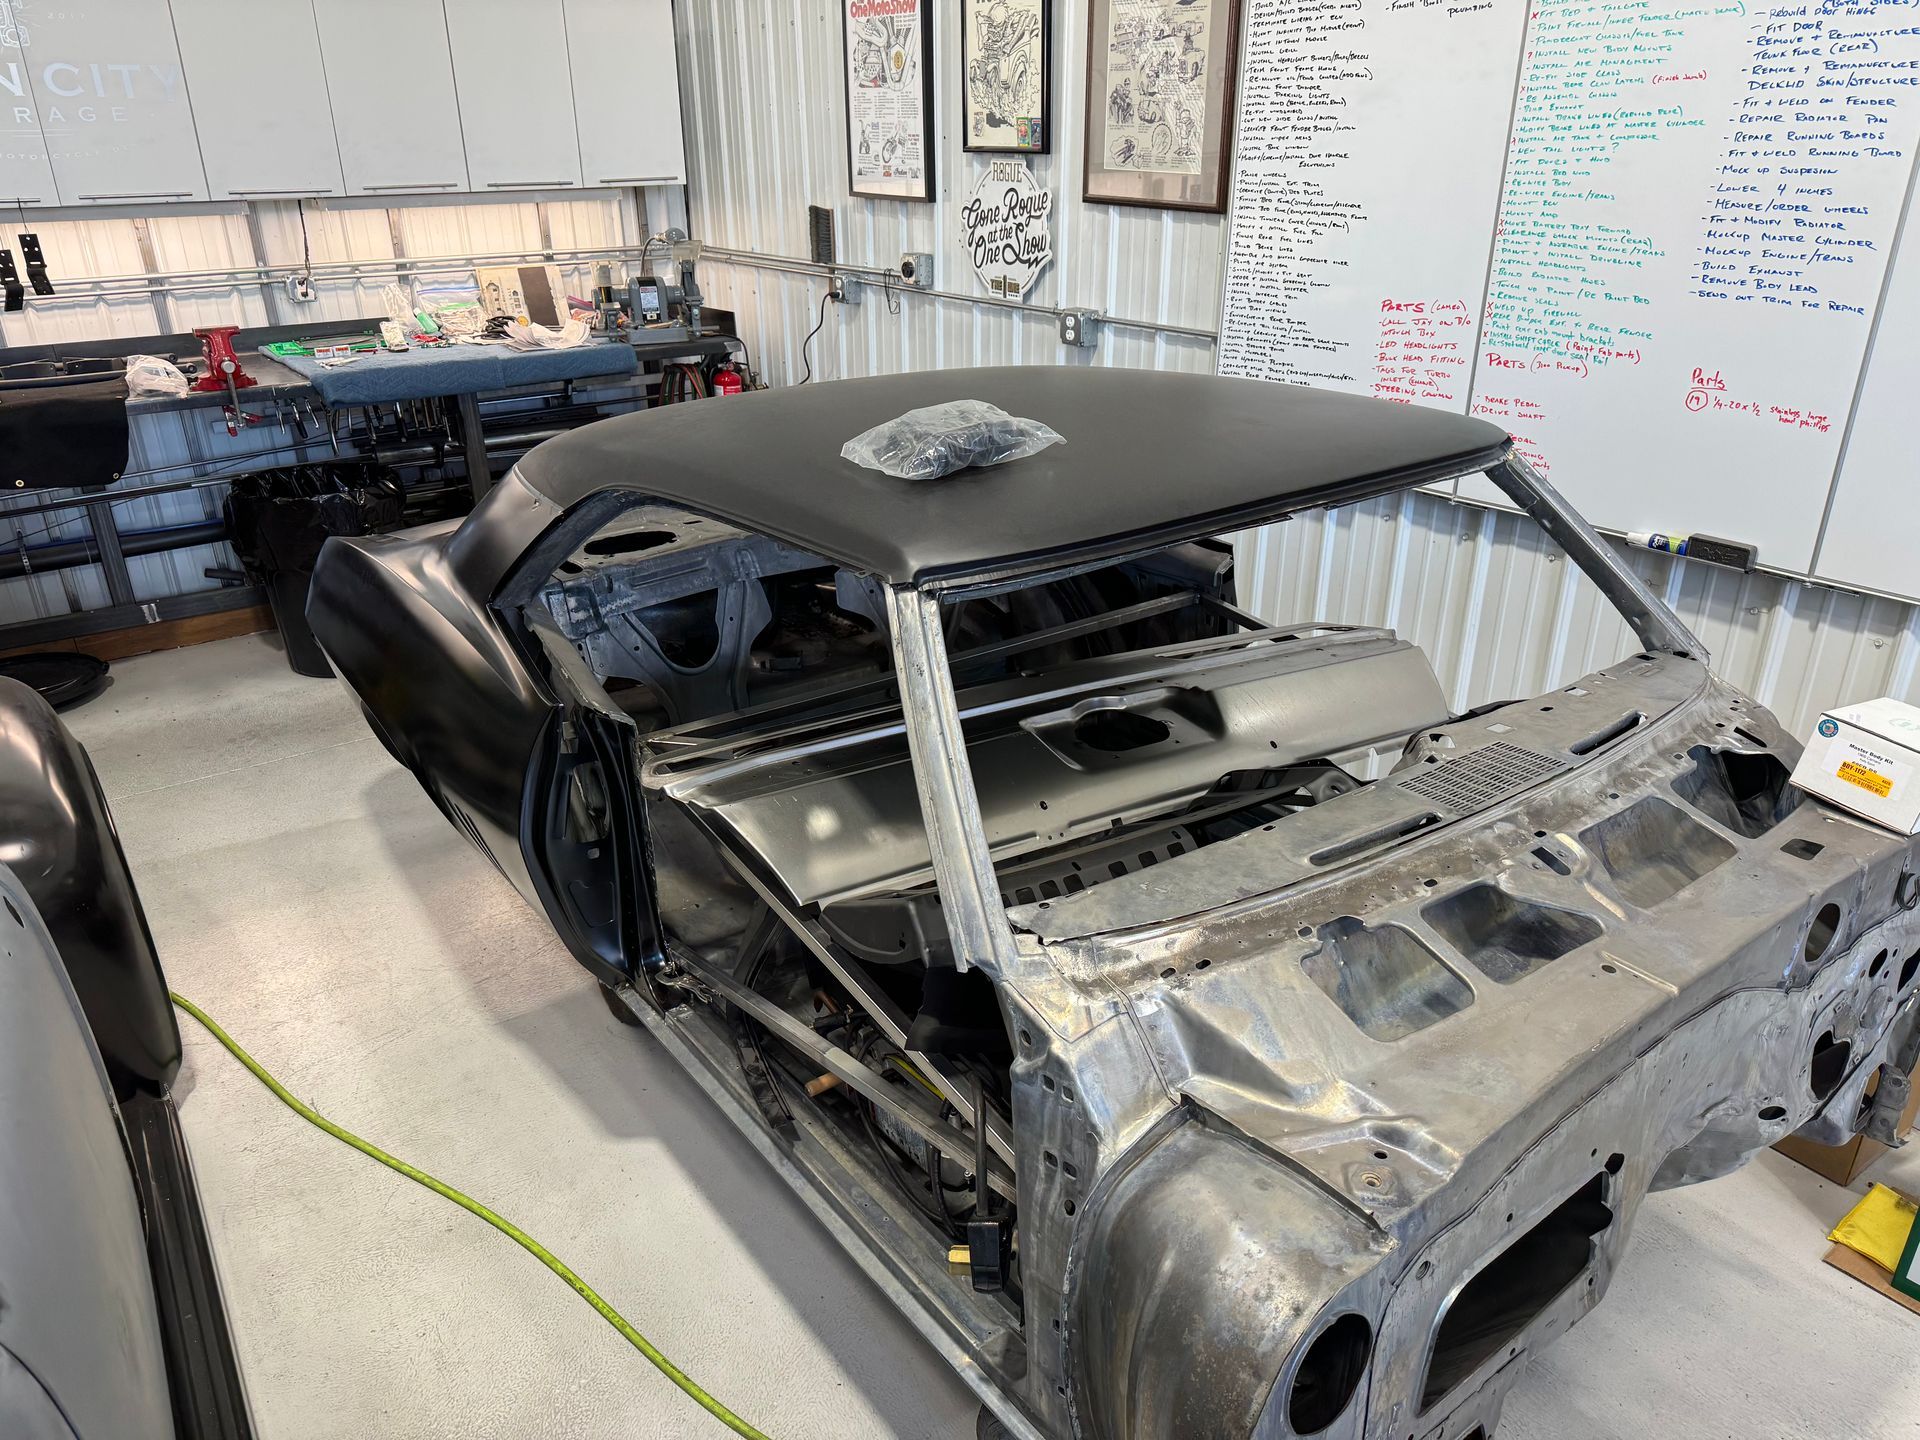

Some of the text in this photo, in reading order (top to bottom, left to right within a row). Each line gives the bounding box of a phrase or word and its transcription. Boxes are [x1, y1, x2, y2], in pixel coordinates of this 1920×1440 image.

[1560, 8, 1581, 17] BED
[1601, 2, 1649, 11] TAILGATE
[1769, 6, 1806, 19] Rebuild
[1766, 21, 1823, 34] FIT DOOR
[1756, 36, 1804, 47] REMOVE
[1534, 50, 1571, 58] INSTALL
[1753, 38, 1879, 61] TRUNK FLOOR (REAR)
[1532, 62, 1568, 70] INSTALL
[1752, 65, 1797, 76] REMOVE
[42, 62, 179, 102] CITY
[1743, 96, 1760, 109] FIT
[1778, 98, 1809, 106] WELD
[1845, 96, 1898, 107] FENDER
[1739, 114, 1785, 123] REPAIR
[1794, 112, 1848, 122] RADIATOR
[1734, 130, 1885, 143] REPAIR RUNNING BOARDS
[1728, 149, 1746, 158] FIT
[1763, 149, 1797, 157] WELD
[1808, 147, 1859, 157] RUNNING
[992, 161, 1023, 183] ROGUE
[1716, 183, 1833, 197] LOWER 4 INCHES
[1714, 198, 1869, 215] MEASURE/ORDER WHEELS
[962, 187, 1049, 248] Gone Rogue
[1709, 215, 1846, 231] FIT MODIFY RADIATOR
[988, 224, 1014, 244] at the
[973, 222, 1049, 270] One Show
[1761, 232, 1805, 243] MASTER
[1815, 235, 1877, 251] CYLINDER
[1761, 248, 1854, 265] ENGINE/TRANS
[1702, 261, 1804, 277] BUILD EXHAUST
[1701, 274, 1818, 294] REMOVE BODY LEAD
[1381, 298, 1425, 313] PARTS
[1698, 290, 1728, 300] SEND
[1762, 296, 1793, 306] TRIM
[1801, 300, 1820, 309] FOR
[1828, 300, 1866, 316] REPAIR
[1382, 316, 1407, 327] CALL
[1379, 339, 1459, 350] LED HEADLIGHTS
[1402, 353, 1424, 362] HEAD
[1429, 354, 1465, 365] FITTING
[1486, 352, 1526, 369] PARTS
[1375, 365, 1396, 374] TAGS
[1400, 366, 1417, 375] FOR
[1691, 367, 1726, 390] Parts
[1374, 383, 1417, 396] STEERING
[1485, 395, 1541, 408] BRAKE PEDAL
[1480, 405, 1509, 416] DRIVE
[1807, 411, 1828, 423] large
[1849, 743, 1869, 755] Master
[1869, 751, 1884, 762] Body
[1884, 757, 1894, 766] Kit
